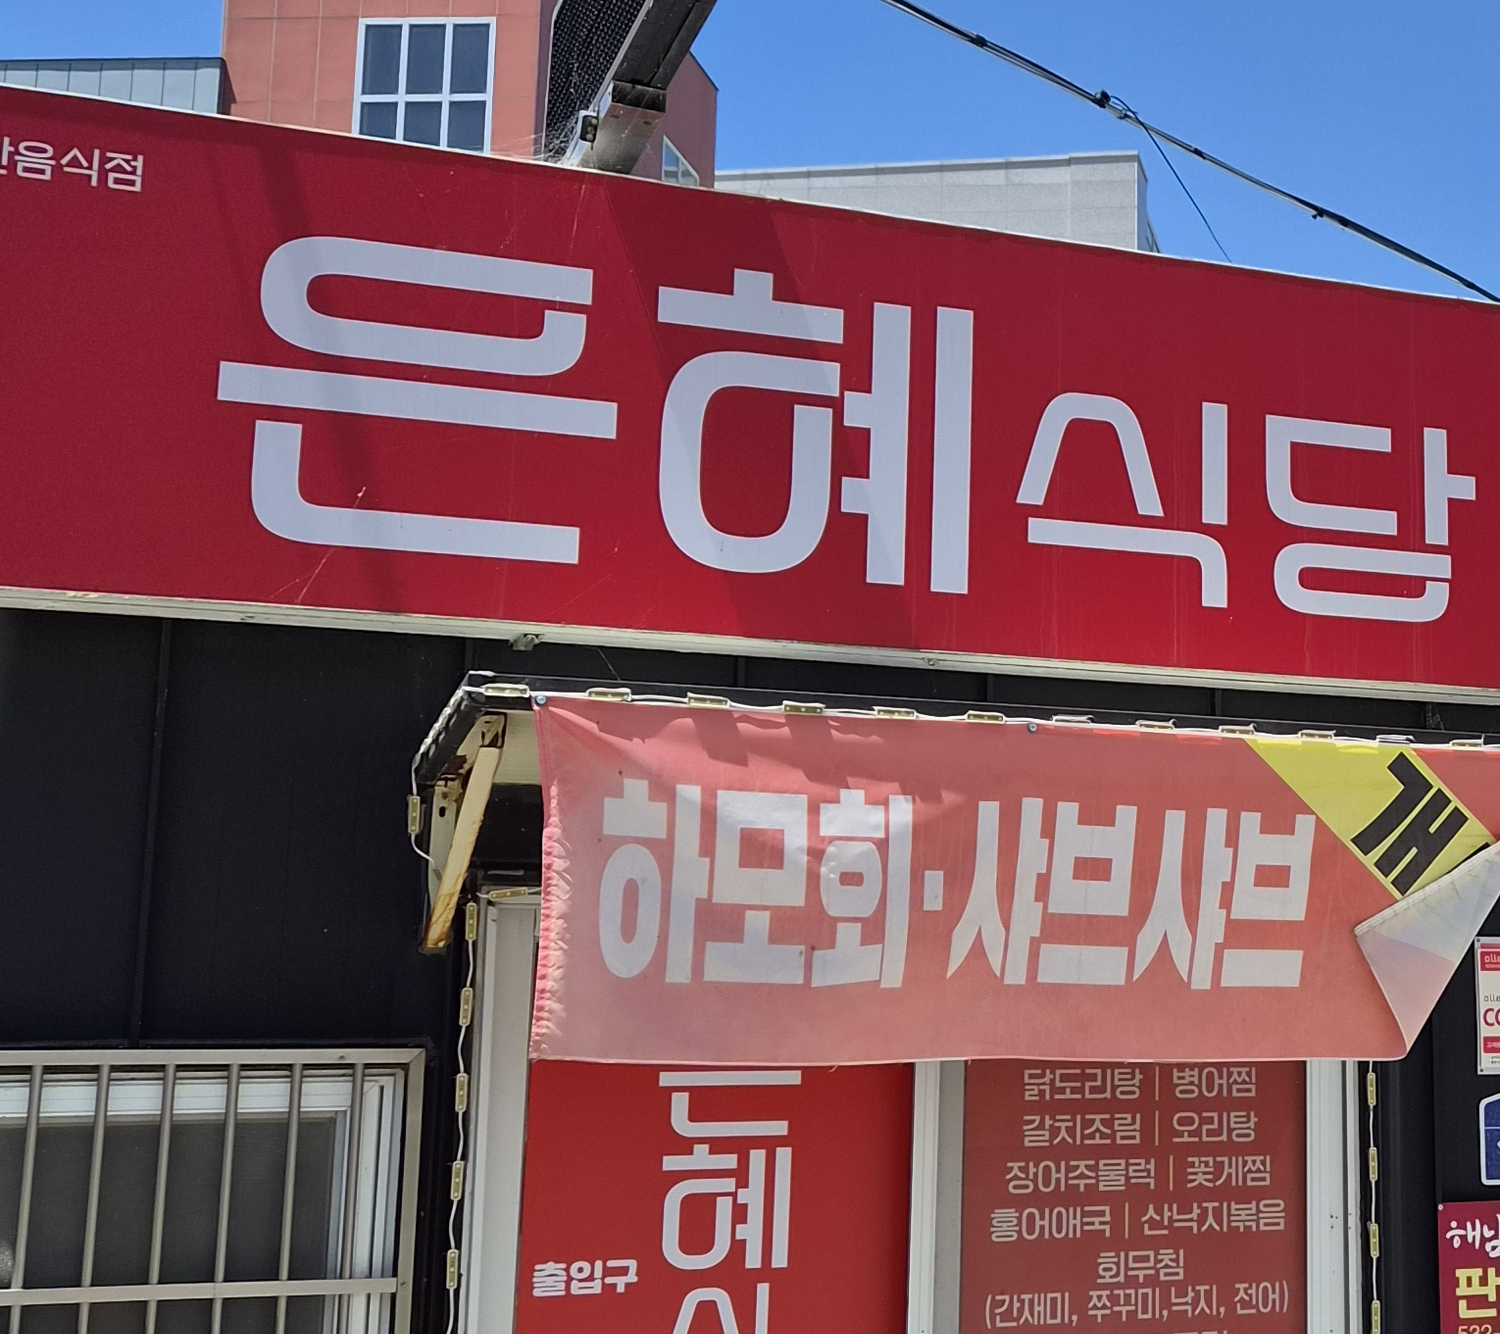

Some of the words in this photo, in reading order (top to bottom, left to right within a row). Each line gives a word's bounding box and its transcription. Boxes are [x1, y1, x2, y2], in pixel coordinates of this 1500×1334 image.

[217, 236, 1476, 622] 은혜식당
[1350, 751, 1491, 897] 개
[1023, 1067, 1143, 1101] 닭도리탕
[1172, 1066, 1257, 1099] 병어찜
[1022, 1113, 1141, 1147] 갈치조림
[1172, 1111, 1258, 1143] 오리탕
[1005, 1158, 1155, 1194] 장어주물럭
[1187, 1155, 1271, 1188] 꽃게찜
[990, 1205, 1111, 1242] 홍어애국
[1141, 1198, 1286, 1236] 산낙지볶음
[532, 1259, 639, 1298] 출입구
[1096, 1249, 1185, 1283] 회무침
[1234, 1280, 1290, 1315] 전어)
